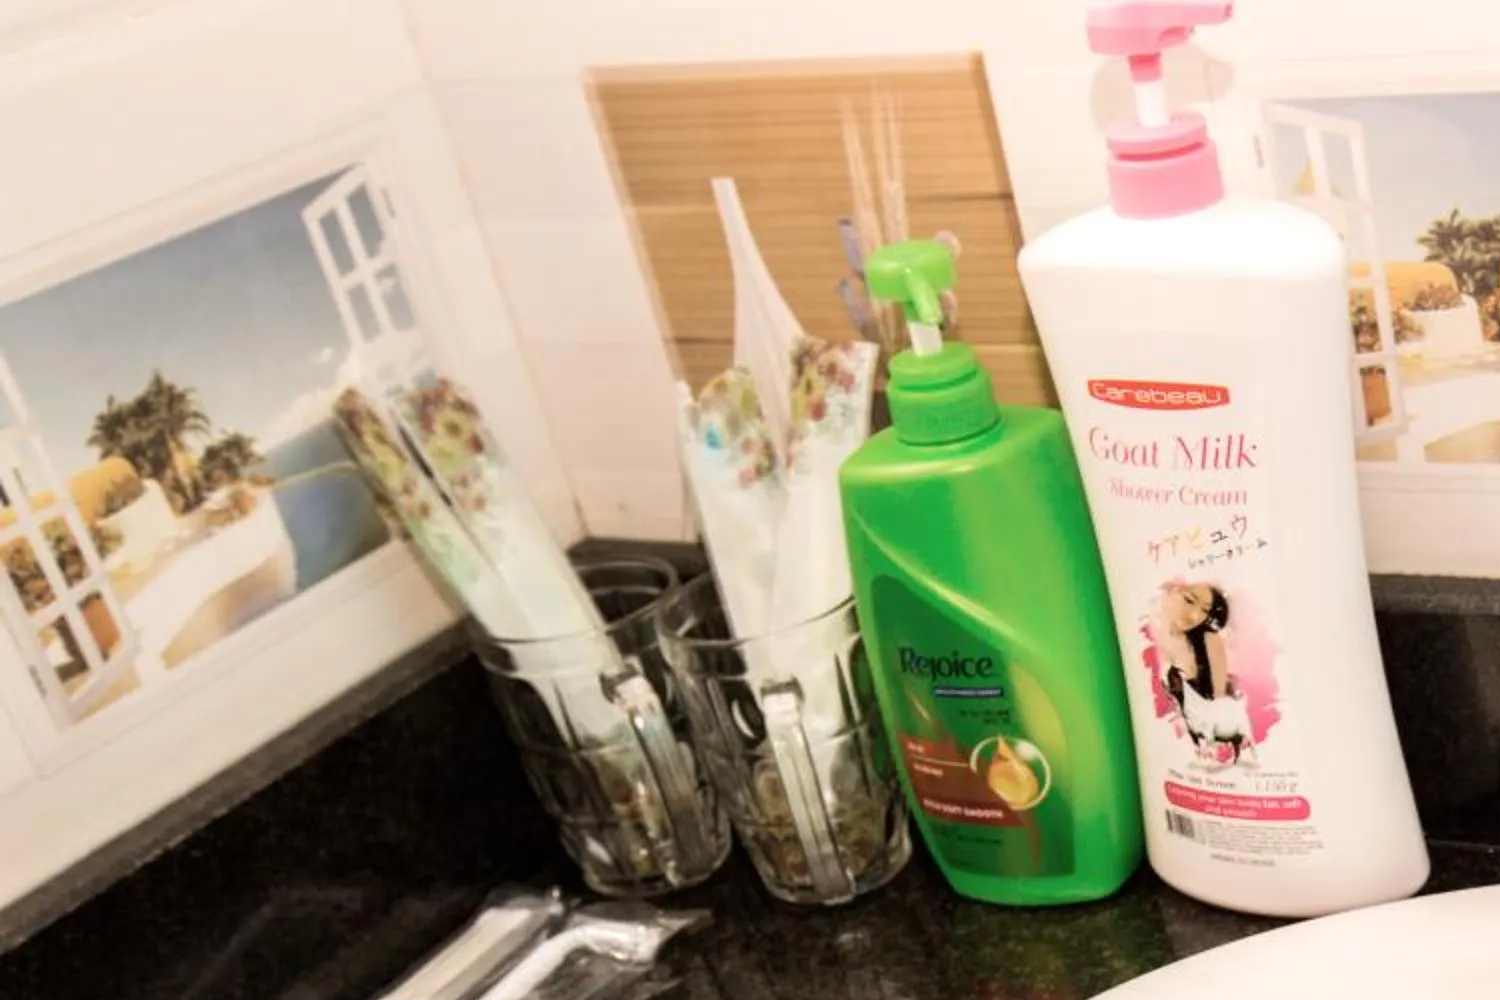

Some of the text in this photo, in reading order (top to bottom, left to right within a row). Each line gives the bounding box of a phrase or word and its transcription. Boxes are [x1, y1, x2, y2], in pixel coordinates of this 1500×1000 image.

[1089, 426, 1258, 471] Goat Milk
[1178, 485, 1248, 506] Cream
[899, 646, 993, 681] Rejoice
